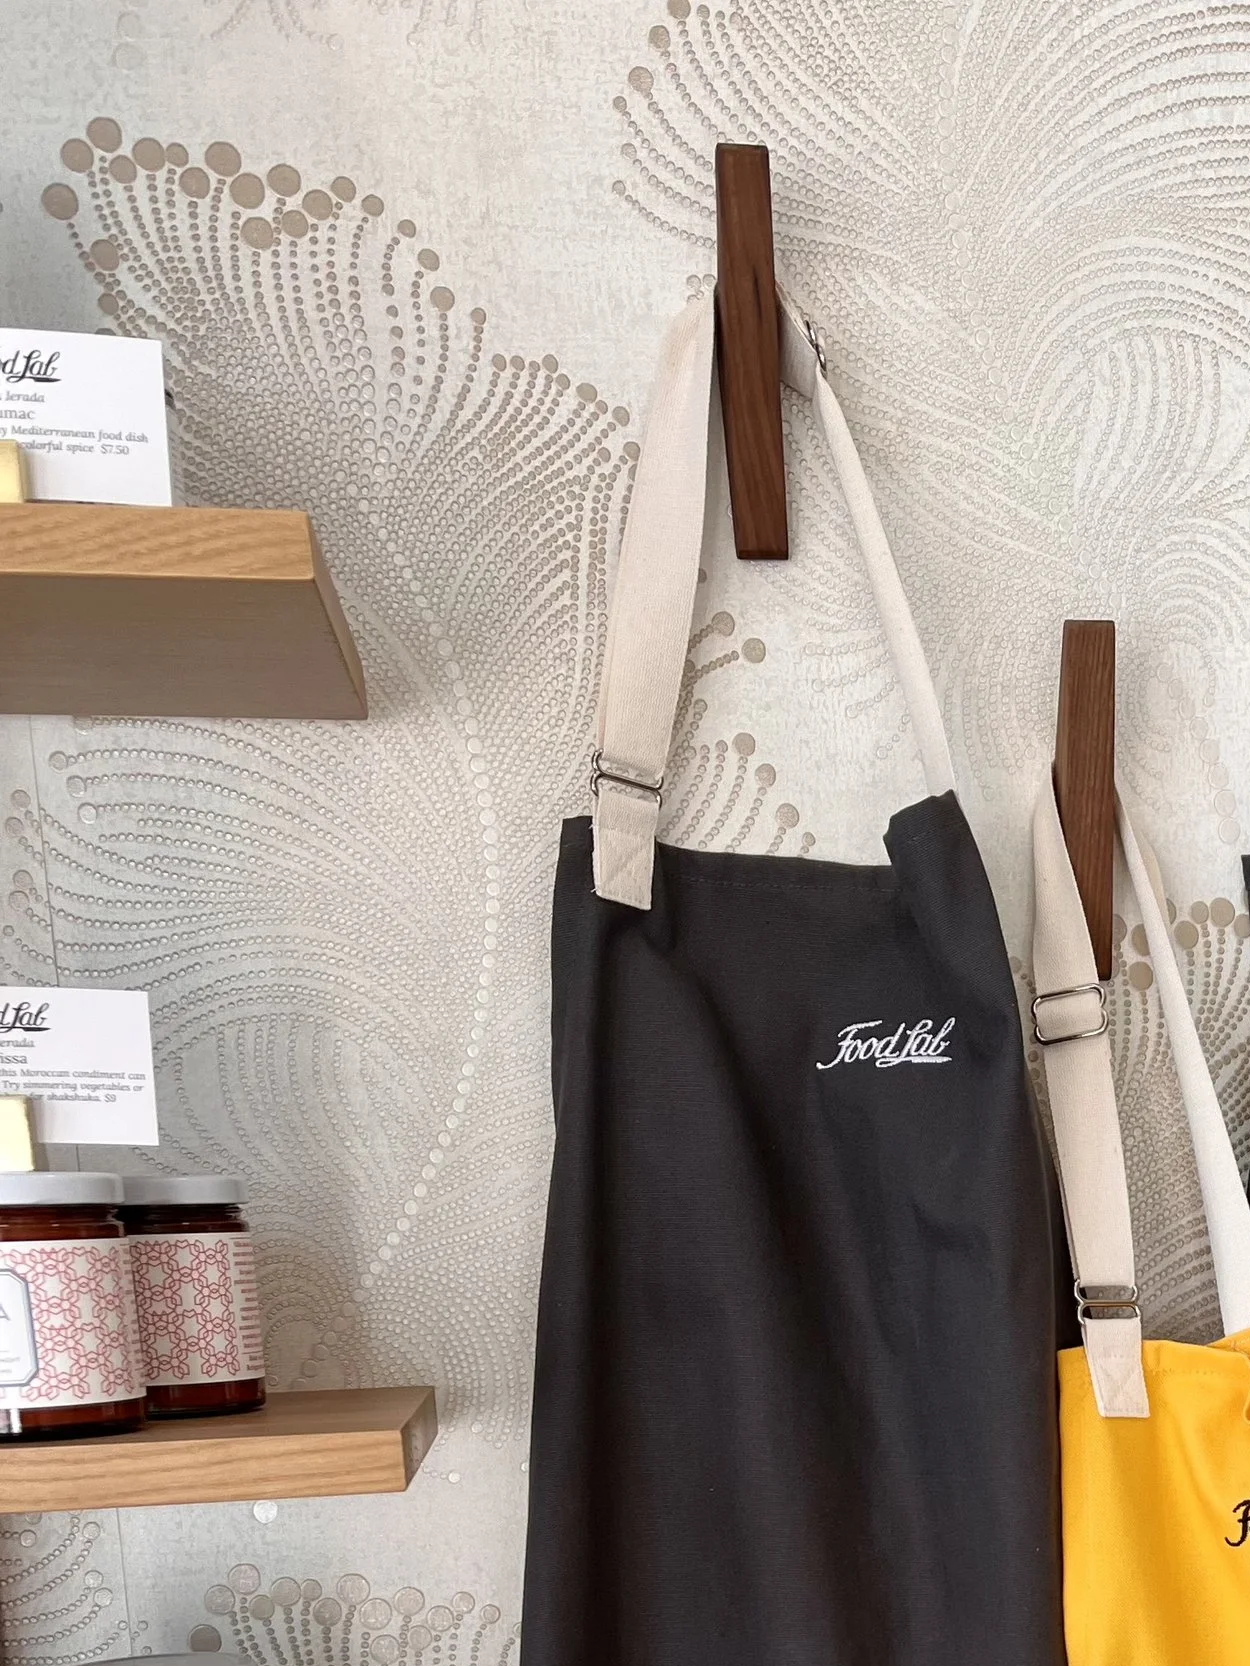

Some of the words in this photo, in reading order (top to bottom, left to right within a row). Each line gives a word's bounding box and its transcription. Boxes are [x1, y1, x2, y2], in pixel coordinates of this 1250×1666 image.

[11, 425, 95, 439] Mediterranean
[97, 429, 122, 441] food
[125, 432, 149, 443] dish
[66, 444, 94, 455] spice
[100, 444, 129, 455] $7.50
[20, 1069, 70, 1078] Moroccan
[72, 1070, 125, 1080] condiment
[128, 1073, 146, 1081] can
[3, 1080, 20, 1091] Try
[23, 1081, 77, 1092] simmering
[80, 1083, 131, 1092] vegetables
